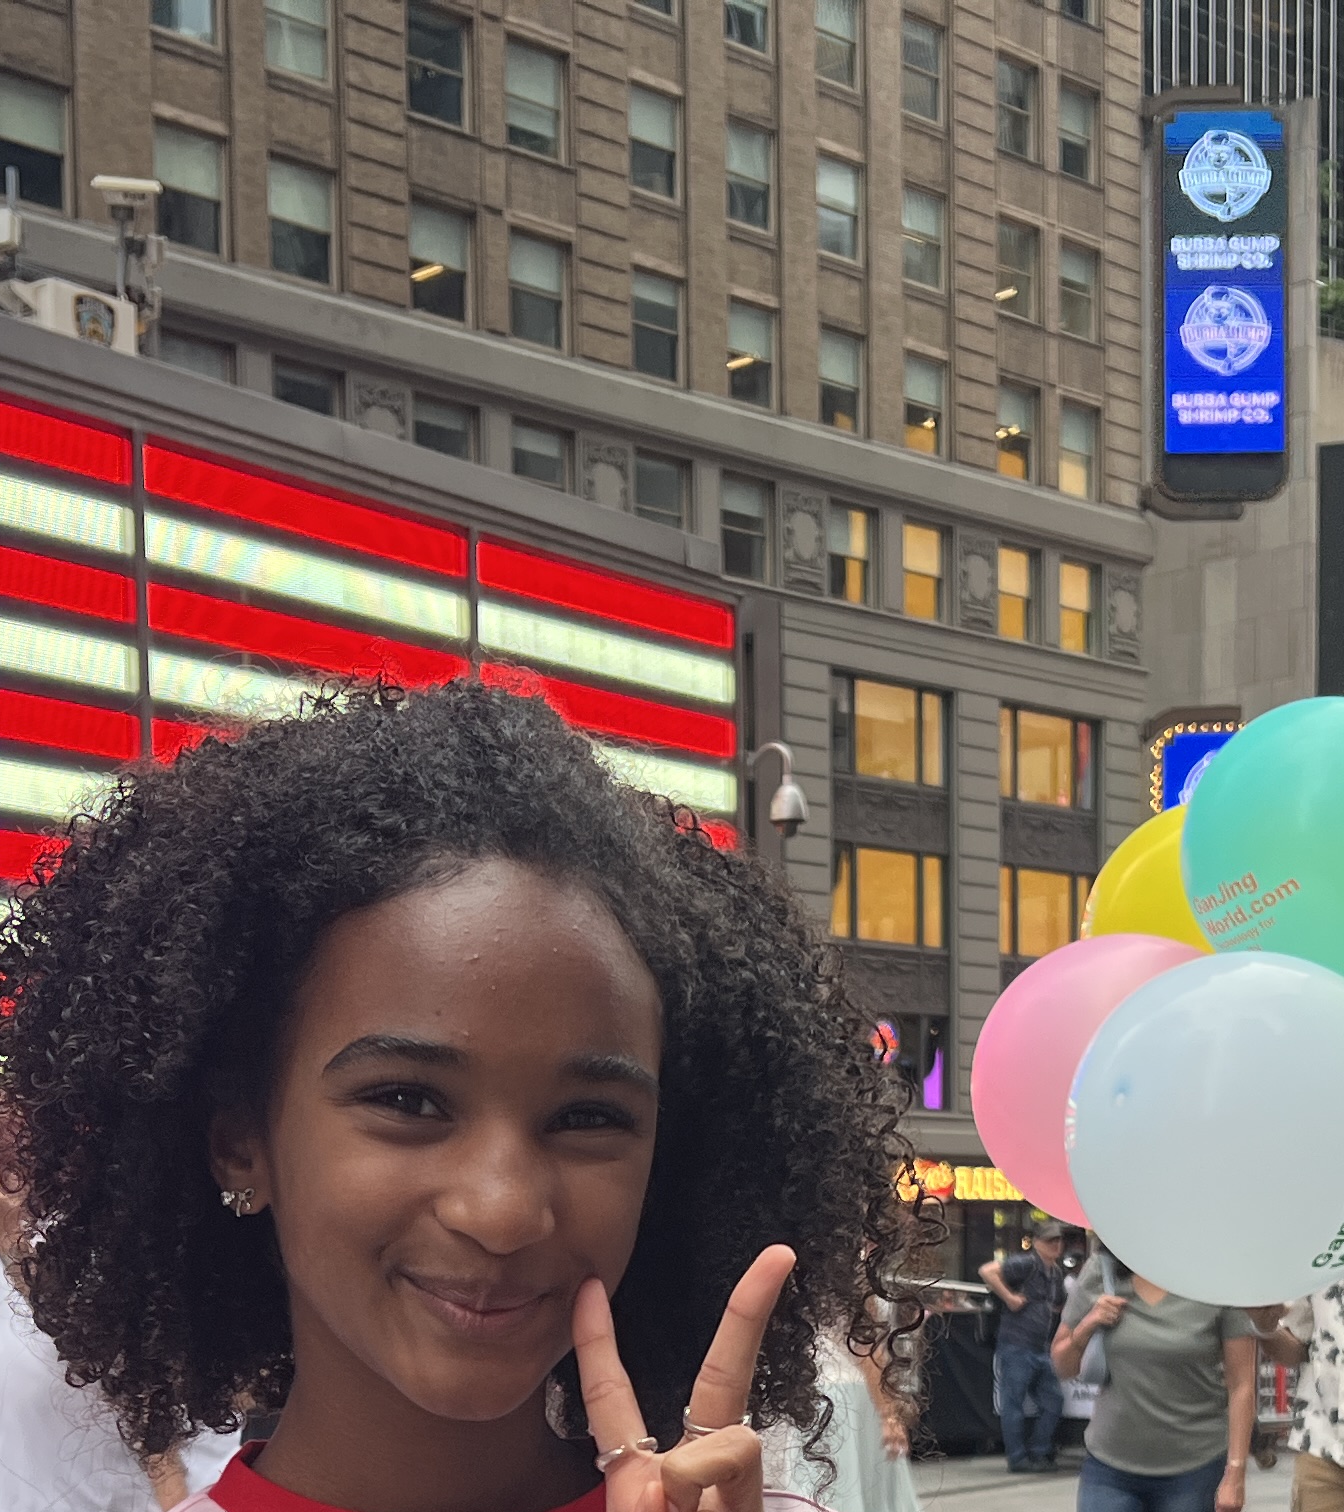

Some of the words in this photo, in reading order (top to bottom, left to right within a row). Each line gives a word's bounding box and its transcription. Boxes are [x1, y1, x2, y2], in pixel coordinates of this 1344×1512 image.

[1171, 236, 1227, 252] BUBBA
[1228, 235, 1279, 251] GUMP
[1177, 253, 1240, 269] SHRIMP
[1172, 392, 1227, 408] BUBBA
[1229, 391, 1279, 407] GUMP
[1178, 408, 1240, 424] SHRIMP
[1193, 872, 1259, 915] GanJing
